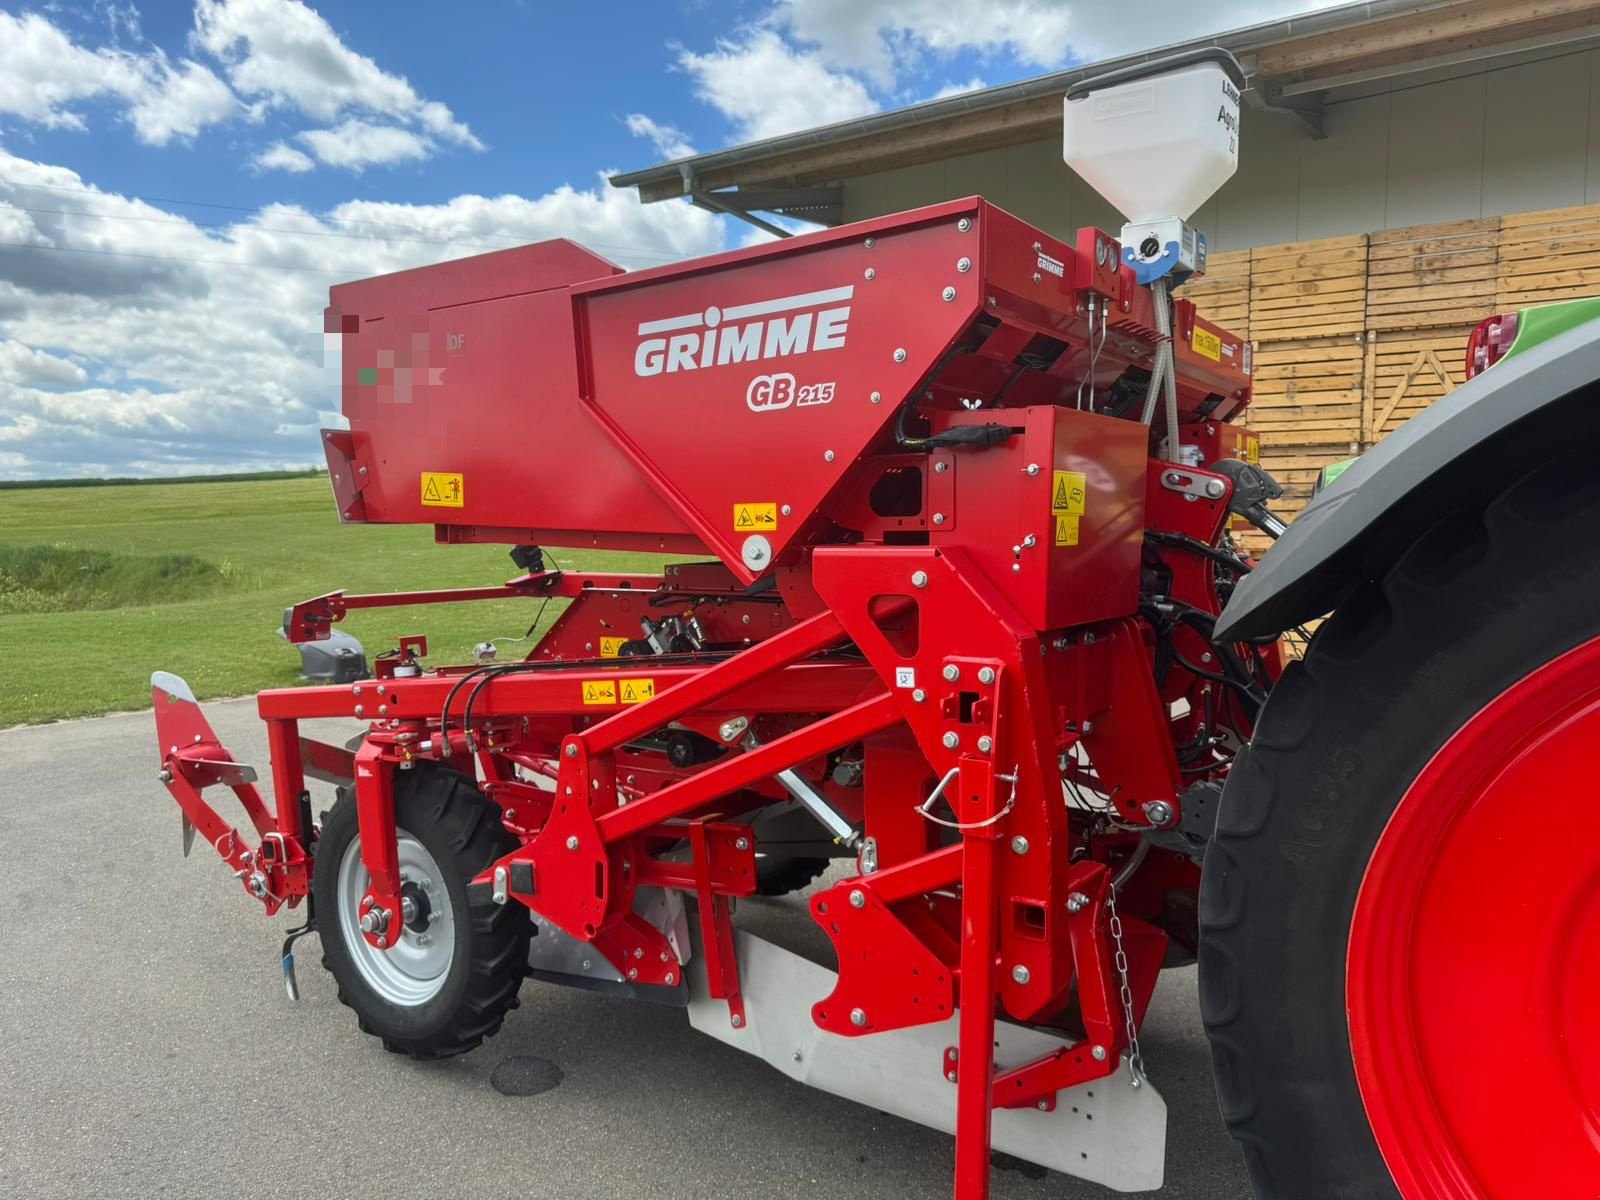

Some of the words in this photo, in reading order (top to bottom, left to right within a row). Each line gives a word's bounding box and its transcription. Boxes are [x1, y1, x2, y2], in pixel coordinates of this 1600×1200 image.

[1037, 253, 1064, 278] GRIMME
[634, 303, 852, 377] GRIMME
[747, 373, 796, 412] GB
[797, 382, 835, 406] 215
